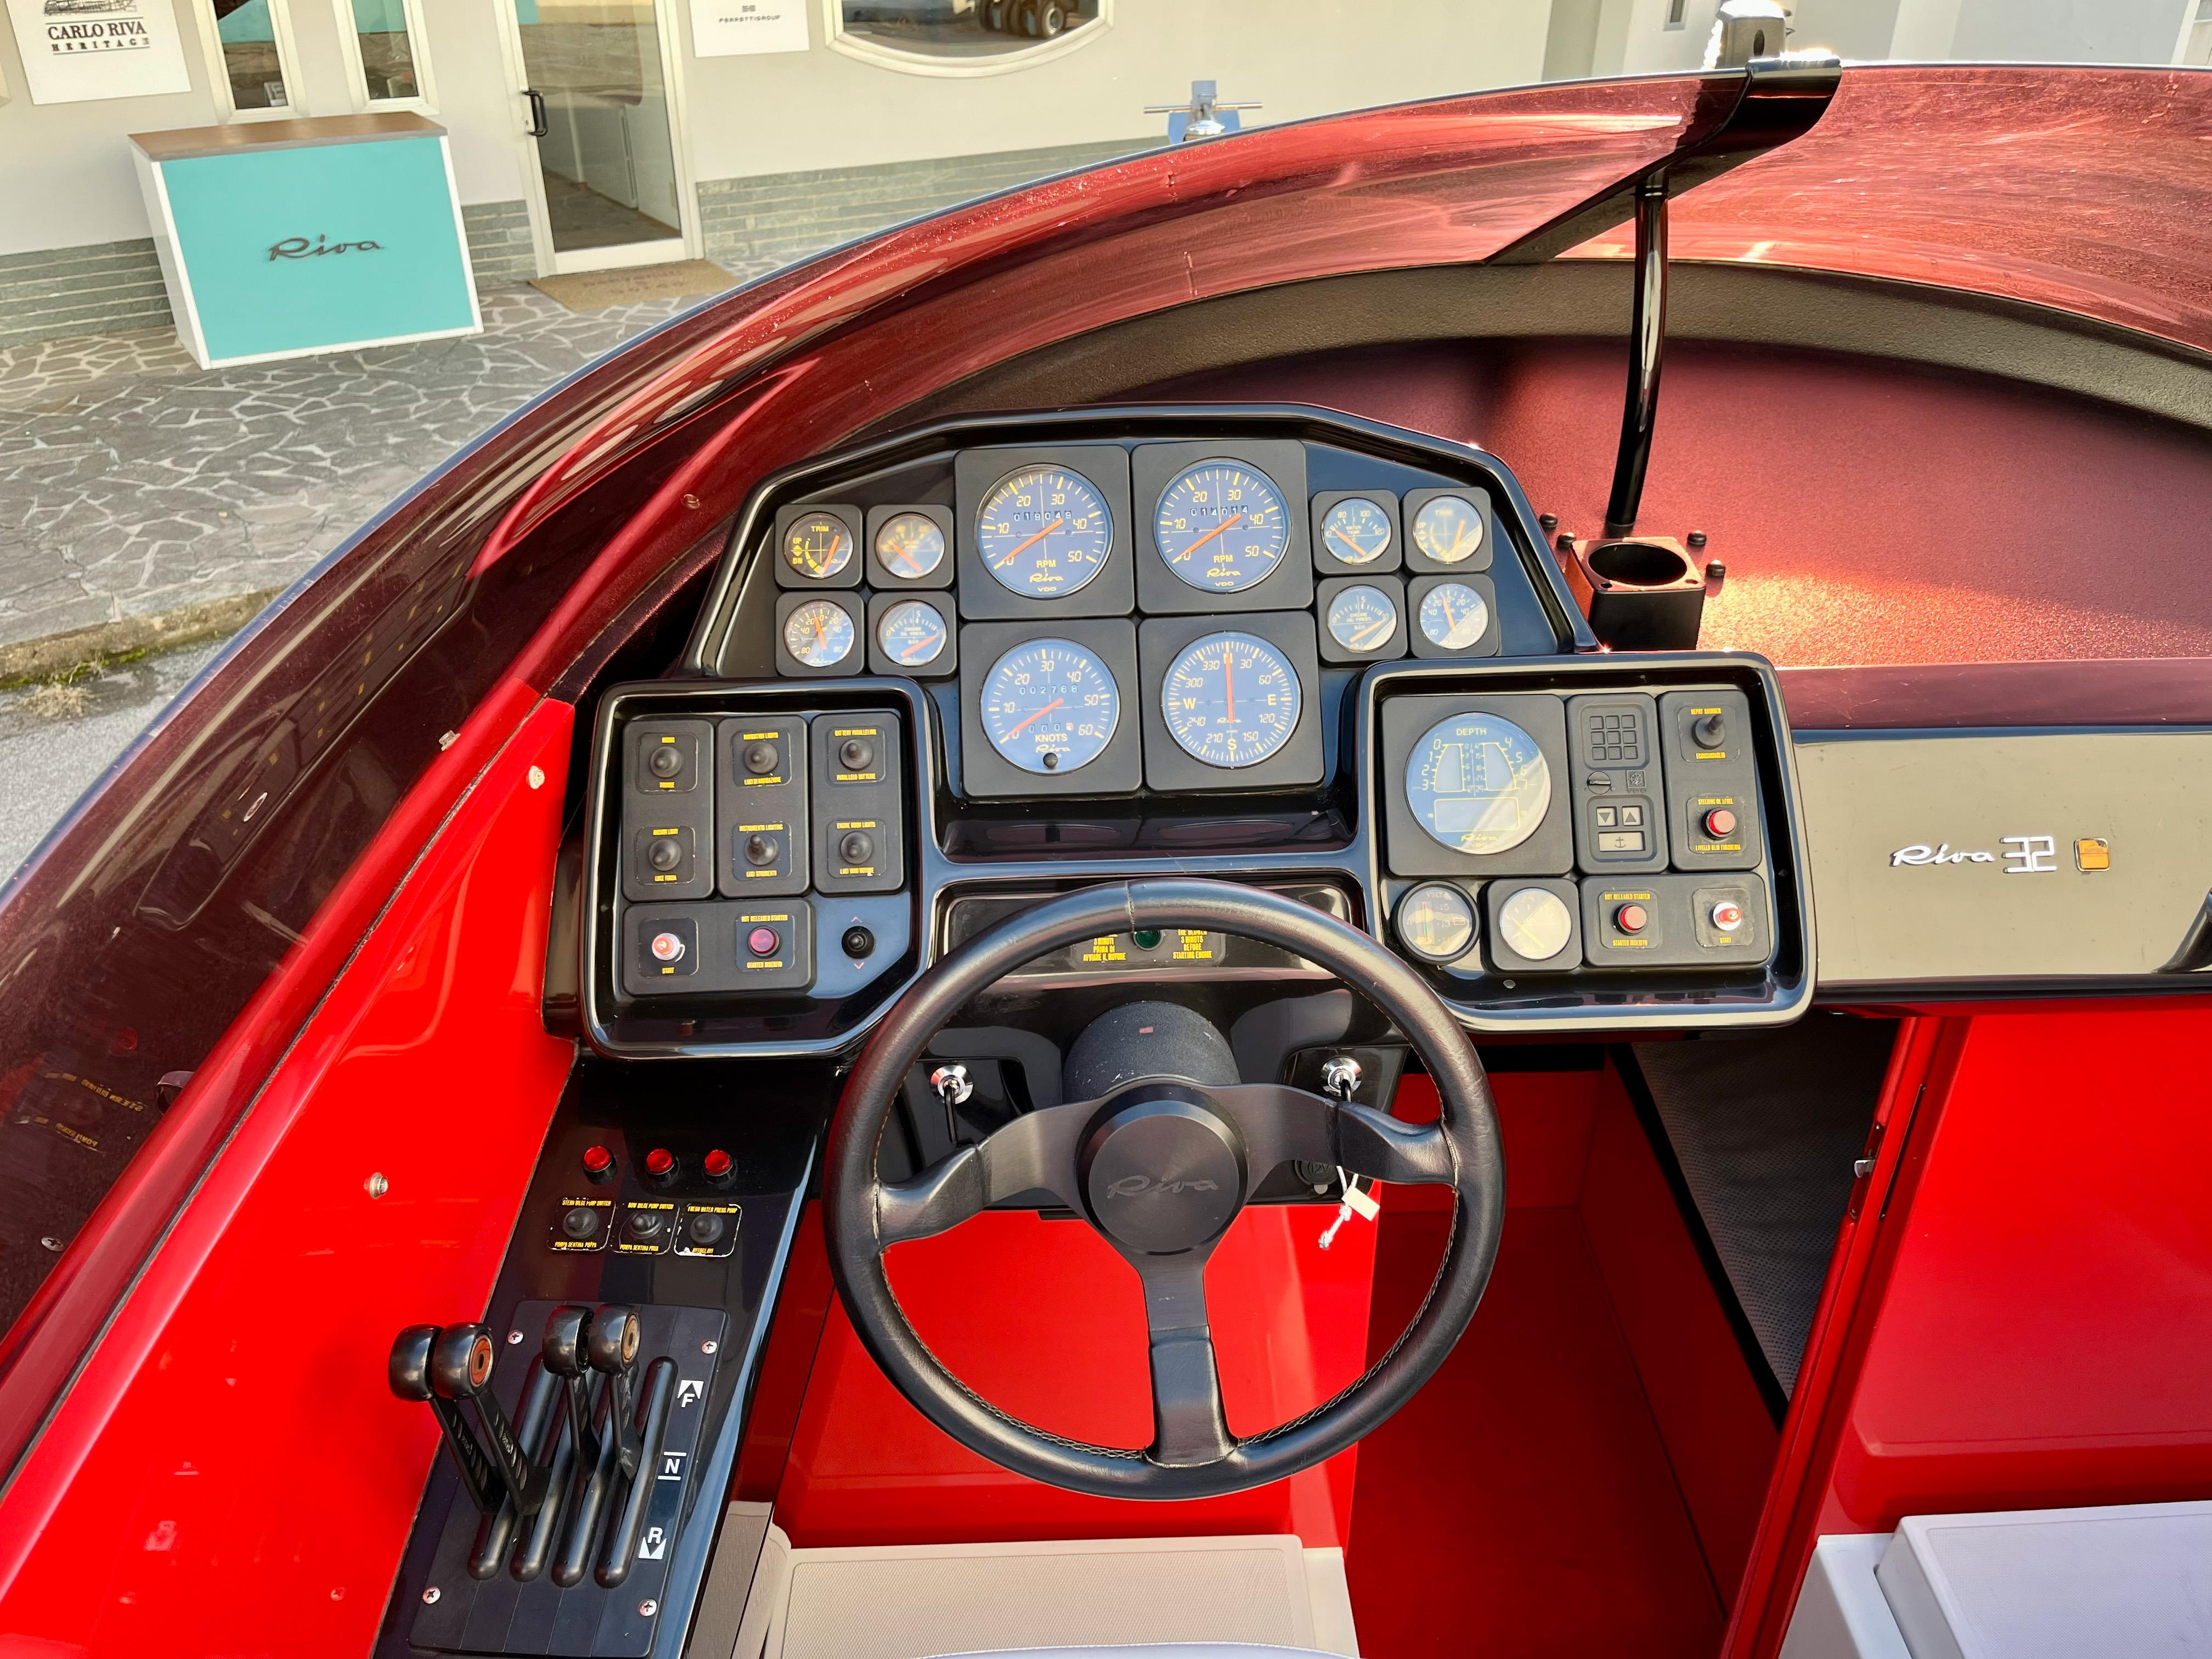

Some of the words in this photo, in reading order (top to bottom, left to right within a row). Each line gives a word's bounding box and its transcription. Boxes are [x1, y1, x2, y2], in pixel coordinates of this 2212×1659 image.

[48, 24, 104, 40] CARLO
[107, 21, 146, 36] RIVA
[52, 38, 149, 52] HERITAGE
[268, 233, 381, 261] Riva
[1051, 494, 1065, 505] 30
[1193, 491, 1207, 503] 20
[1227, 489, 1241, 501] 30
[1017, 495, 1031, 507] 20
[1073, 518, 1087, 529] 40
[1174, 518, 1186, 529] 10
[1250, 514, 1263, 525] 40
[997, 523, 1009, 534] 10
[1068, 550, 1082, 562] 50
[1245, 546, 1259, 557] 50
[1036, 560, 1056, 568] RPM
[1214, 555, 1233, 563] RPM
[1030, 573, 1064, 583] Riva
[1206, 568, 1241, 577] Riva
[1040, 661, 1054, 672] 30
[1202, 660, 1220, 670] 330
[1240, 659, 1252, 669] 30
[1015, 674, 1030, 685] 20
[1067, 671, 1081, 682] 40
[1259, 675, 1271, 685] 60
[1185, 678, 1203, 687] 300
[1084, 695, 1098, 706] 50
[1183, 698, 1196, 709] W
[1267, 694, 1277, 706] E
[1003, 702, 1015, 713] 10
[1187, 716, 1206, 727] 240
[1259, 713, 1275, 724] 120
[1079, 724, 1093, 735] 60
[1035, 733, 1068, 742] KNOTS
[1206, 733, 1223, 743] 210
[1242, 731, 1259, 742] 150
[1505, 737, 1512, 747] 4
[1036, 743, 1071, 753] Riva
[1227, 738, 1237, 751] S
[1433, 739, 1441, 750] 0
[1429, 752, 1433, 762] 1
[1422, 764, 1430, 776] 2
[1520, 765, 1527, 776] 6
[1422, 779, 1429, 791] 3
[1461, 833, 1497, 842] Riva
[1889, 843, 1995, 867] Riva
[2000, 836, 2057, 873] 32
[1107, 1172, 1219, 1199] Riva
[681, 1393, 695, 1408] F
[665, 1458, 680, 1474] N
[648, 1527, 663, 1544] R
